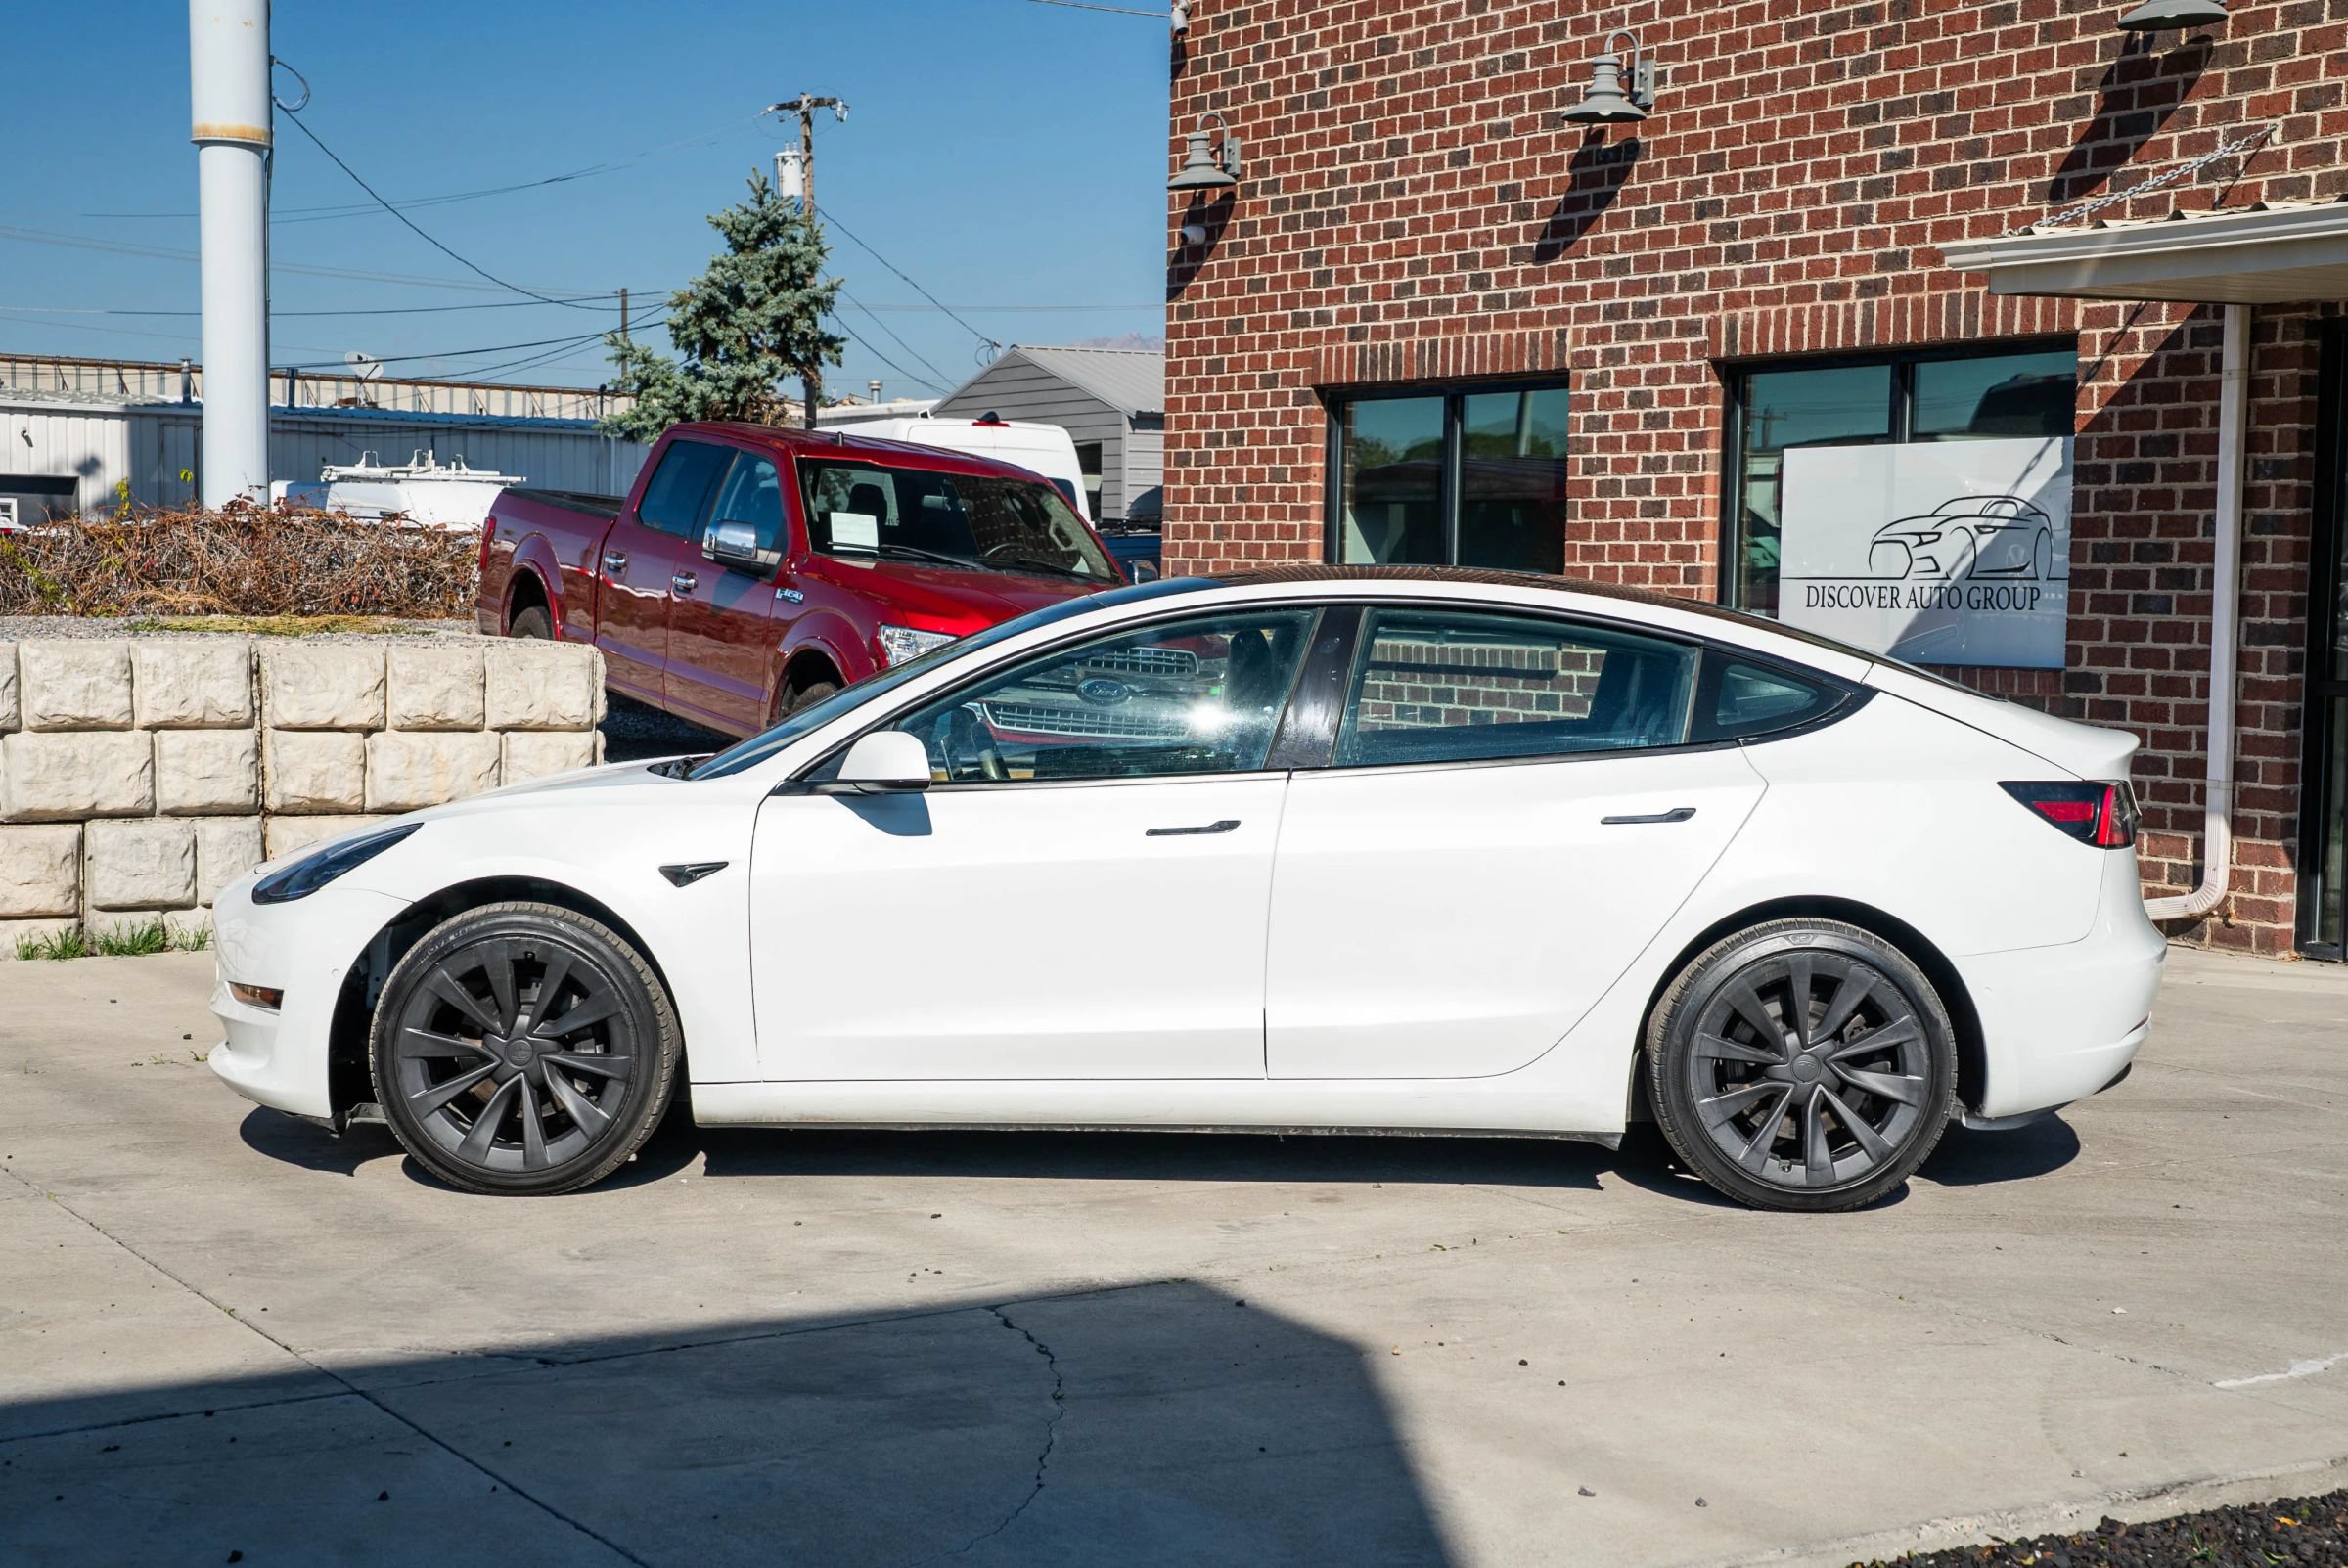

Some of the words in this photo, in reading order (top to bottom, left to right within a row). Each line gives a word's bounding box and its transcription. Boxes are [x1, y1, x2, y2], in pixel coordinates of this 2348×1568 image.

[1805, 585, 1902, 609] DISCOVER
[1905, 586, 1963, 610] AUTO
[1966, 586, 2041, 611] GROUP
